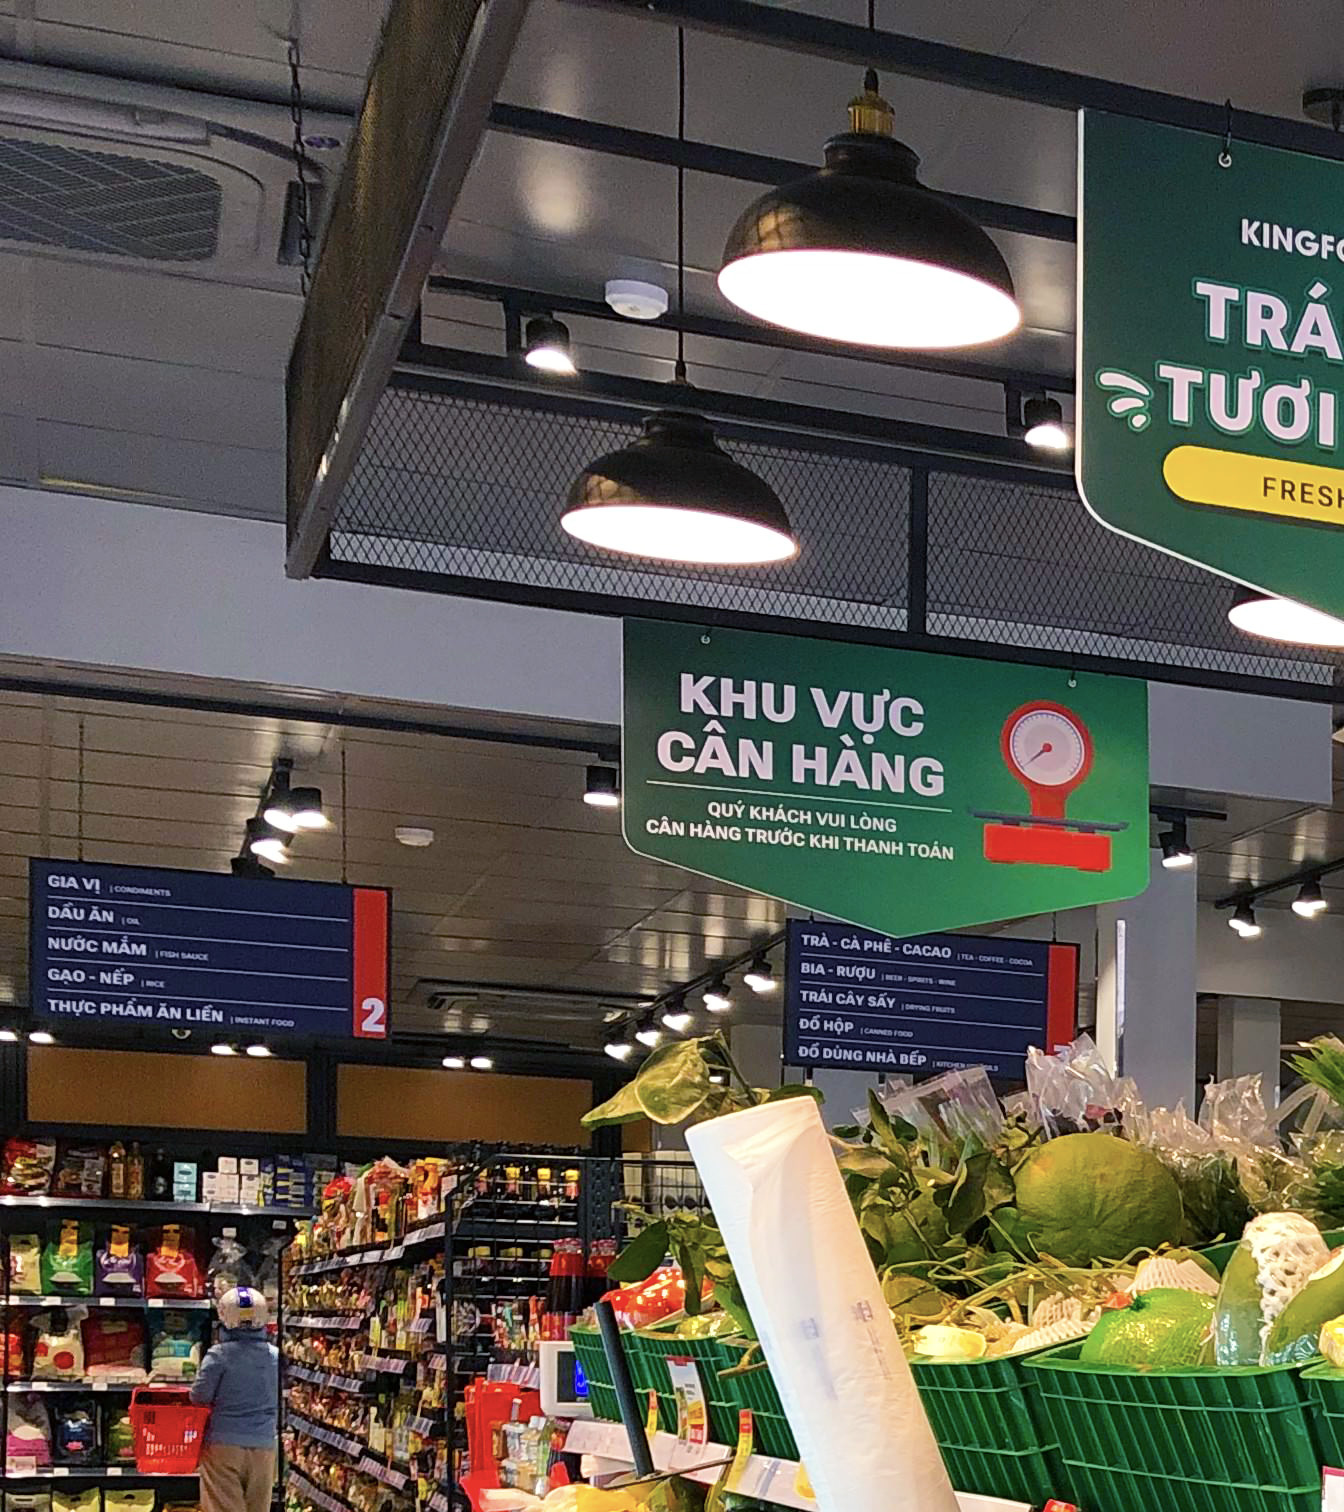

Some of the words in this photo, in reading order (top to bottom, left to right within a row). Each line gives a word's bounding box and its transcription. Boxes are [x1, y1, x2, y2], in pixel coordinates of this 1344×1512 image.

[1156, 363, 1336, 448] TƯƠI
[679, 672, 796, 721] KHU
[810, 687, 925, 745] VỰC
[656, 719, 774, 780] CÂN
[792, 734, 946, 797] HÀNG
[707, 799, 746, 820] QUÝ
[749, 802, 812, 826] KHÁCH
[816, 810, 846, 828] VUI
[849, 809, 898, 833] LÒNG
[645, 815, 686, 837] CÂN
[689, 817, 742, 841] HÀNG
[744, 823, 806, 847] TRƯỚC
[808, 832, 840, 851] KHI
[842, 836, 904, 857] THANH
[906, 838, 955, 861] TOÁN
[48, 874, 79, 890] GIA
[82, 878, 100, 895] VỊ
[48, 902, 85, 921] DẦU
[88, 905, 114, 923] ĂN
[48, 934, 99, 952] NƯỚC
[102, 936, 147, 956] MẮM
[801, 933, 830, 948] TRÀ
[840, 937, 861, 951] CÀ
[864, 938, 892, 954] PHÊ
[903, 943, 952, 959] CACAO
[48, 968, 85, 985] GẠO
[100, 967, 134, 986] NẾP
[801, 962, 825, 976] BIA
[836, 965, 876, 982] RƯỢU
[48, 998, 96, 1017] THỰC
[100, 997, 152, 1019] PHẨM
[157, 1003, 182, 1020] ĂN
[186, 1004, 224, 1023] LIỀN
[801, 989, 832, 1003] TRÁI
[835, 990, 864, 1006] CÂY
[868, 992, 895, 1009] SẤY
[360, 996, 386, 1032] 2
[824, 1017, 854, 1036] HỘP
[823, 1043, 863, 1062] DÙNG
[866, 1047, 897, 1064] NHÀ
[900, 1049, 927, 1067] BẾP
